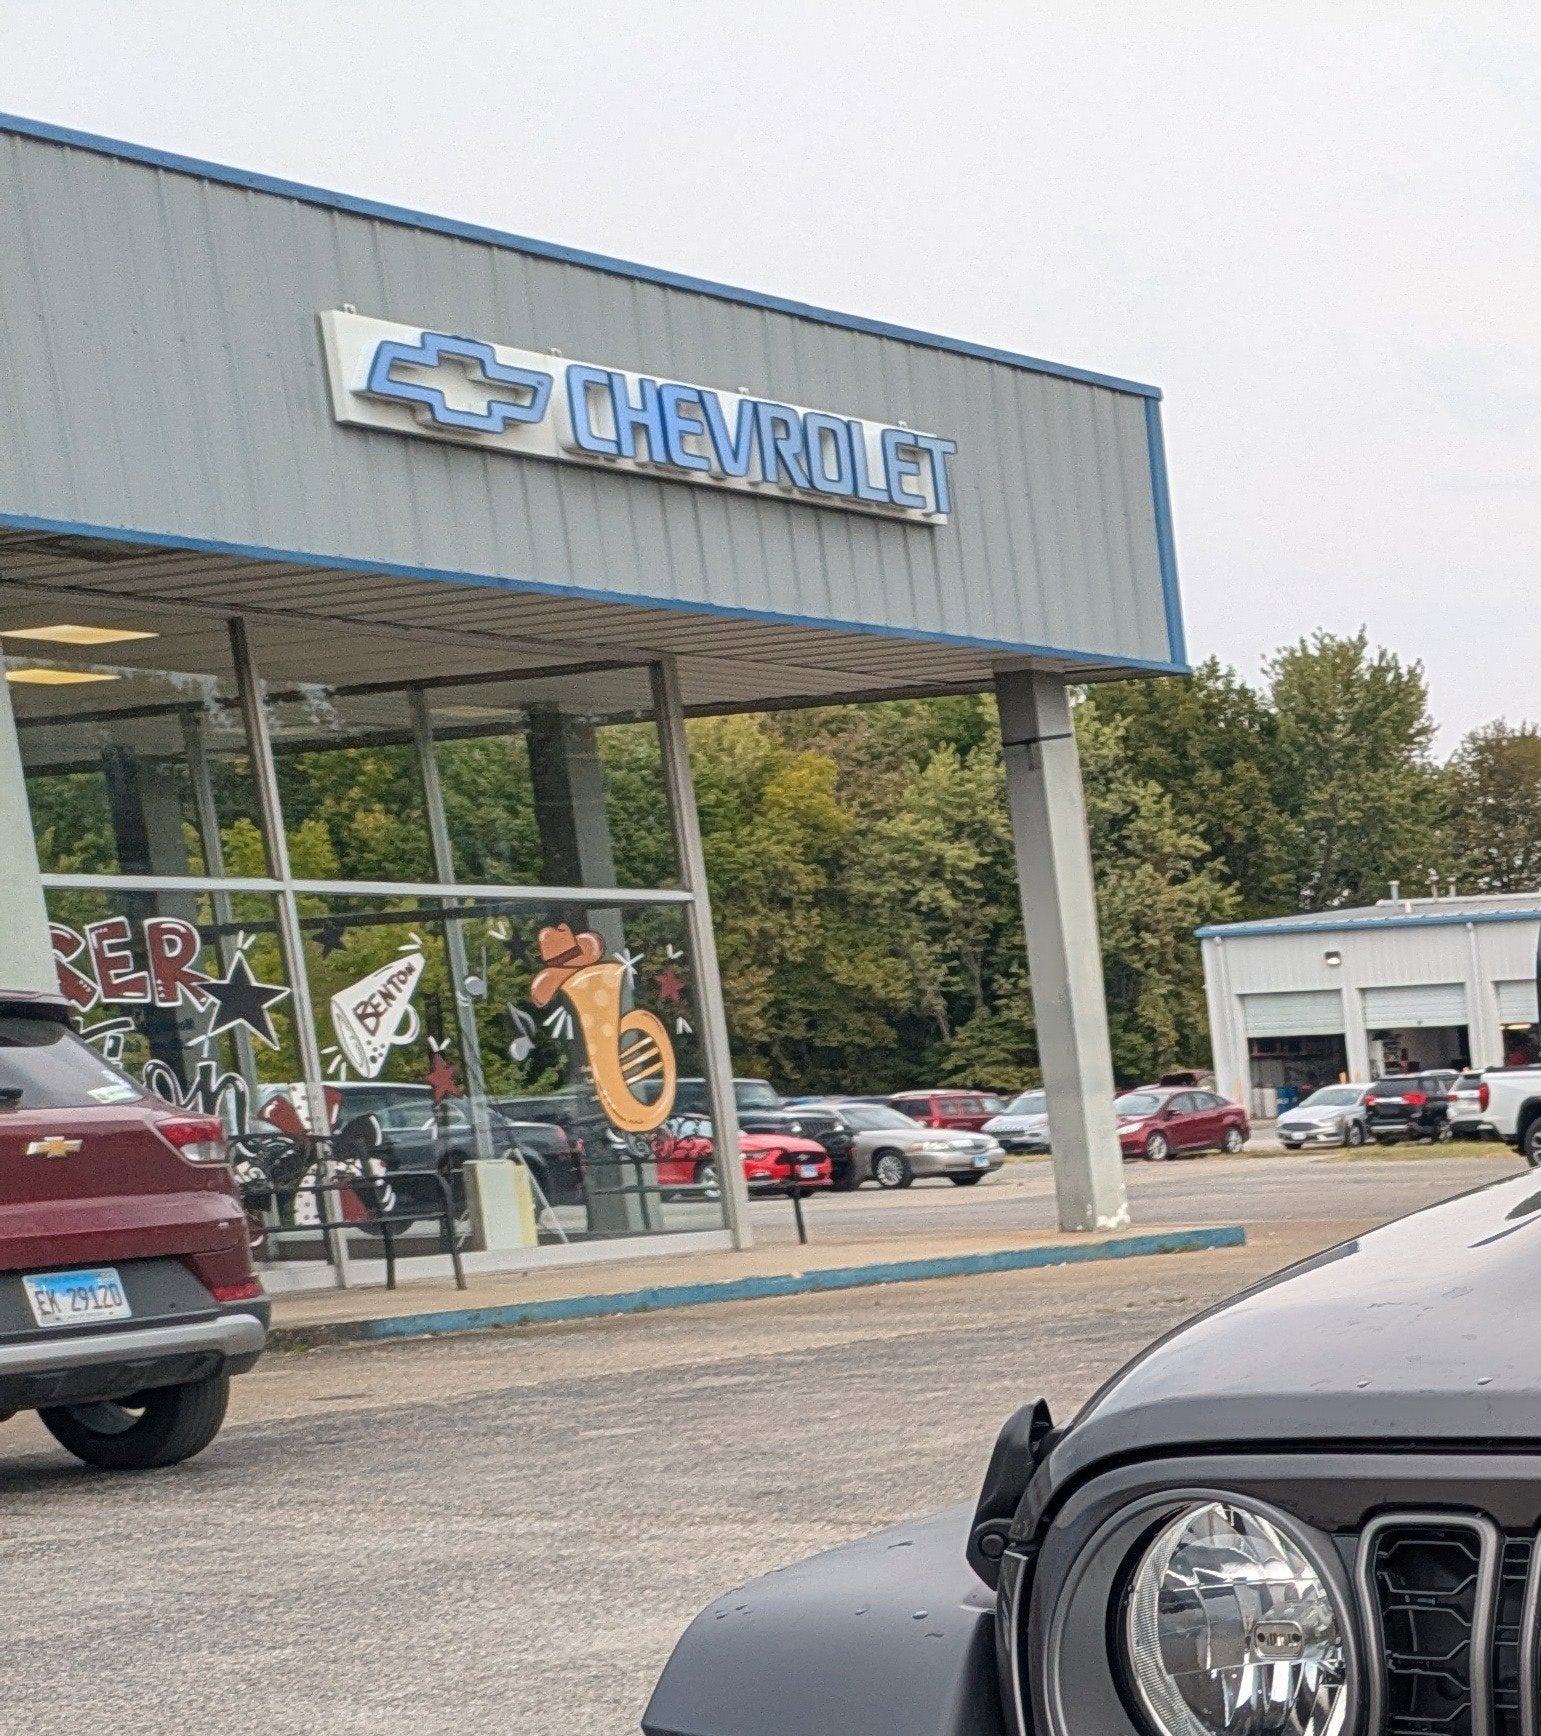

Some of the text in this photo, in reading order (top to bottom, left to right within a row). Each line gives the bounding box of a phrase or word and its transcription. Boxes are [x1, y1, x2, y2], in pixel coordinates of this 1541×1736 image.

[565, 363, 957, 514] CHEVROLET
[352, 962, 416, 1037] BENTON
[34, 1283, 123, 1315] EK 29120
